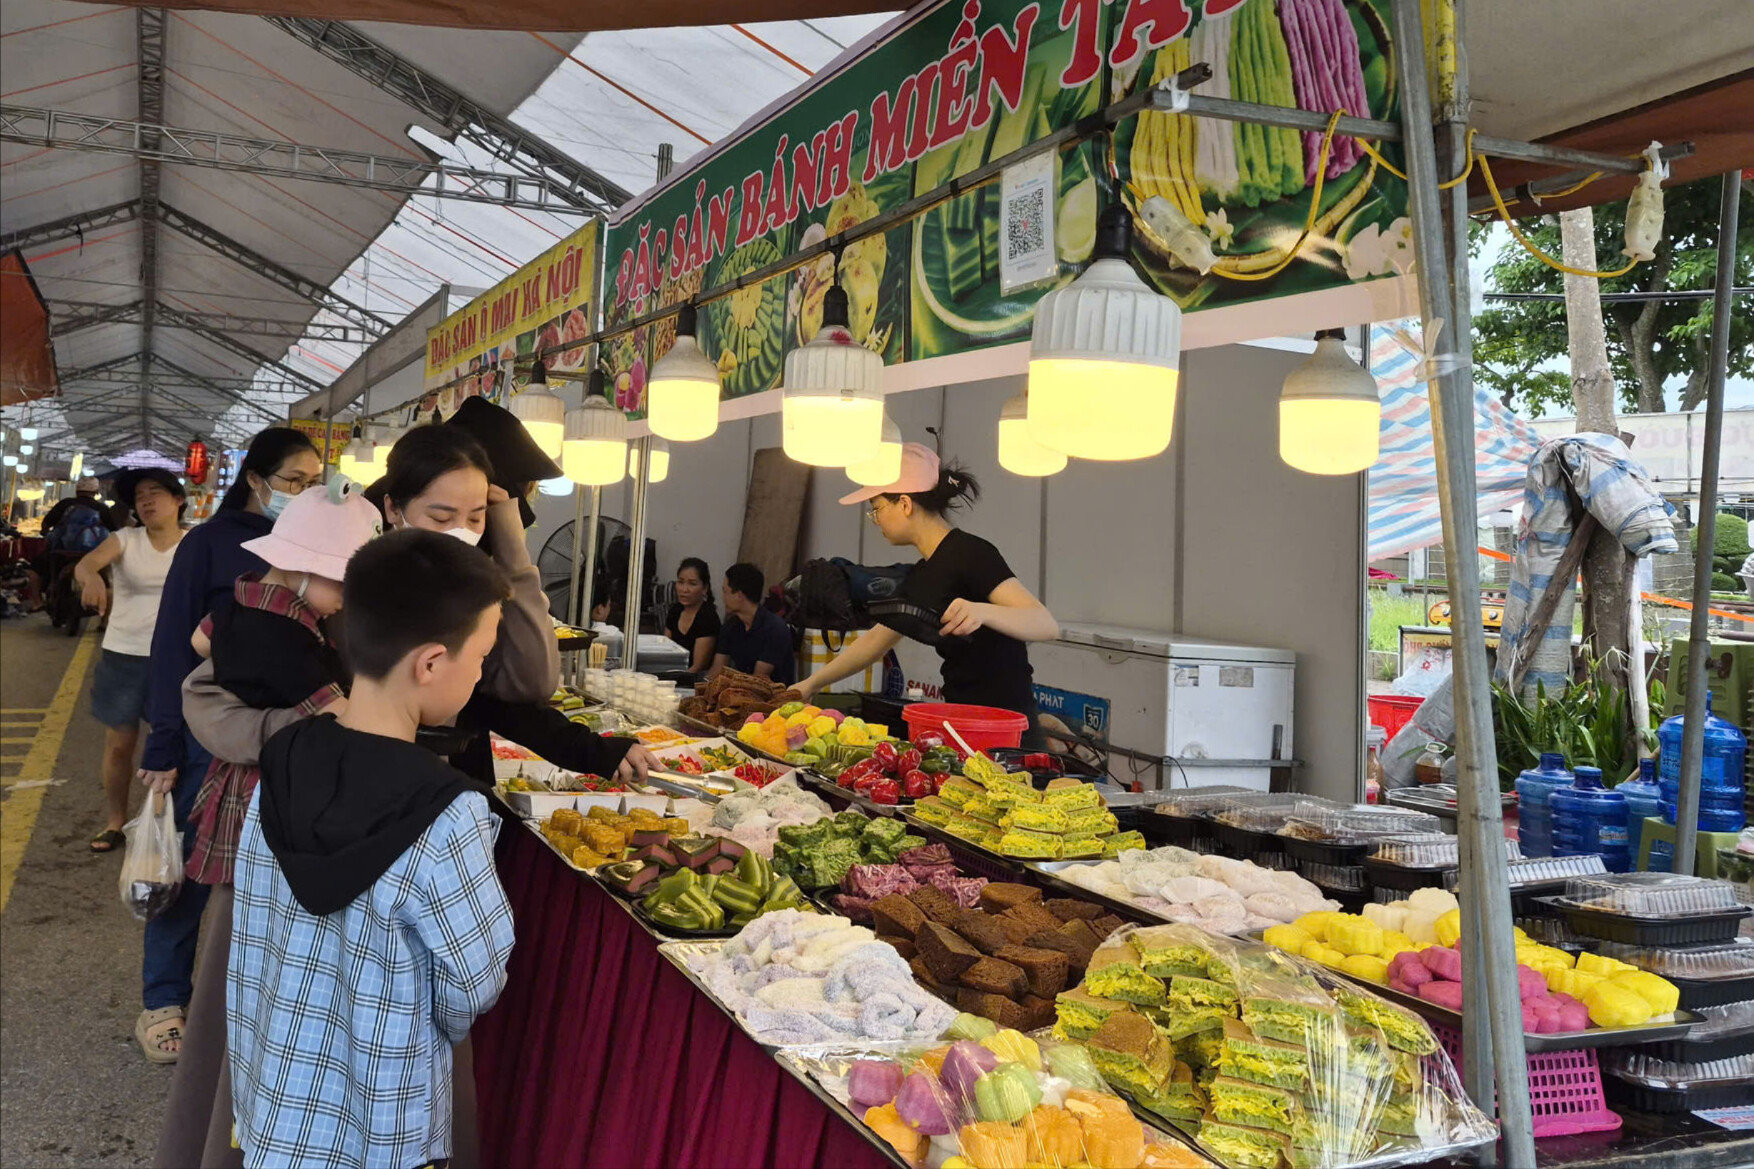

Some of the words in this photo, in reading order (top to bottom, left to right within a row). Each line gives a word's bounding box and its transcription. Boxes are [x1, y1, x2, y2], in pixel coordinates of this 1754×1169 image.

[615, 220, 667, 314] ĐẶC
[670, 179, 734, 281] SẢN
[735, 110, 858, 248] BÁNH
[862, 0, 1040, 184] MIỀN
[491, 288, 519, 335] MAI
[546, 245, 584, 304] NỘI
[1087, 713, 1099, 728] 30
